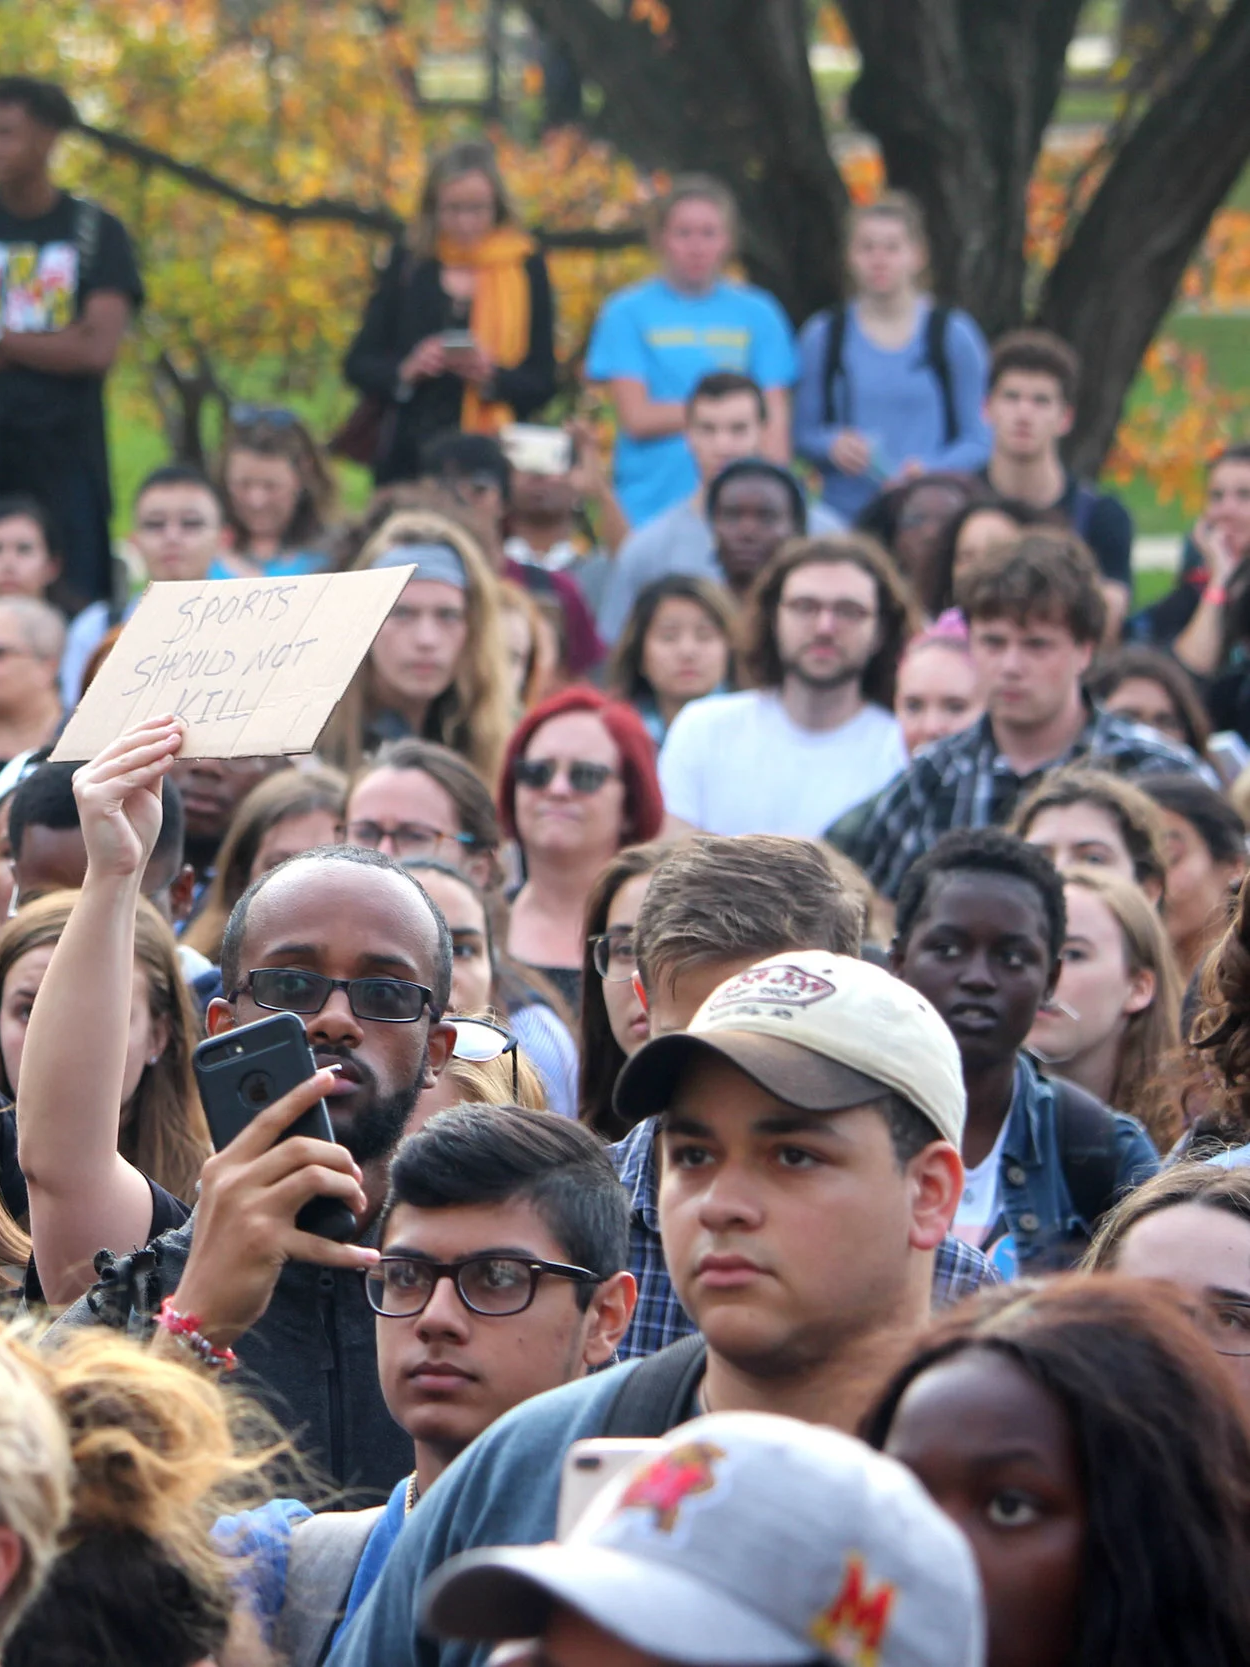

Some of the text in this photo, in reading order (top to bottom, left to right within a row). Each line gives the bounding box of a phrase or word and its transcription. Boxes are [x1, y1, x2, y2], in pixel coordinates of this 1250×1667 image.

[162, 585, 298, 644] SPORTS
[122, 638, 318, 696] SHOULD NOT
[173, 688, 253, 729] KILL
